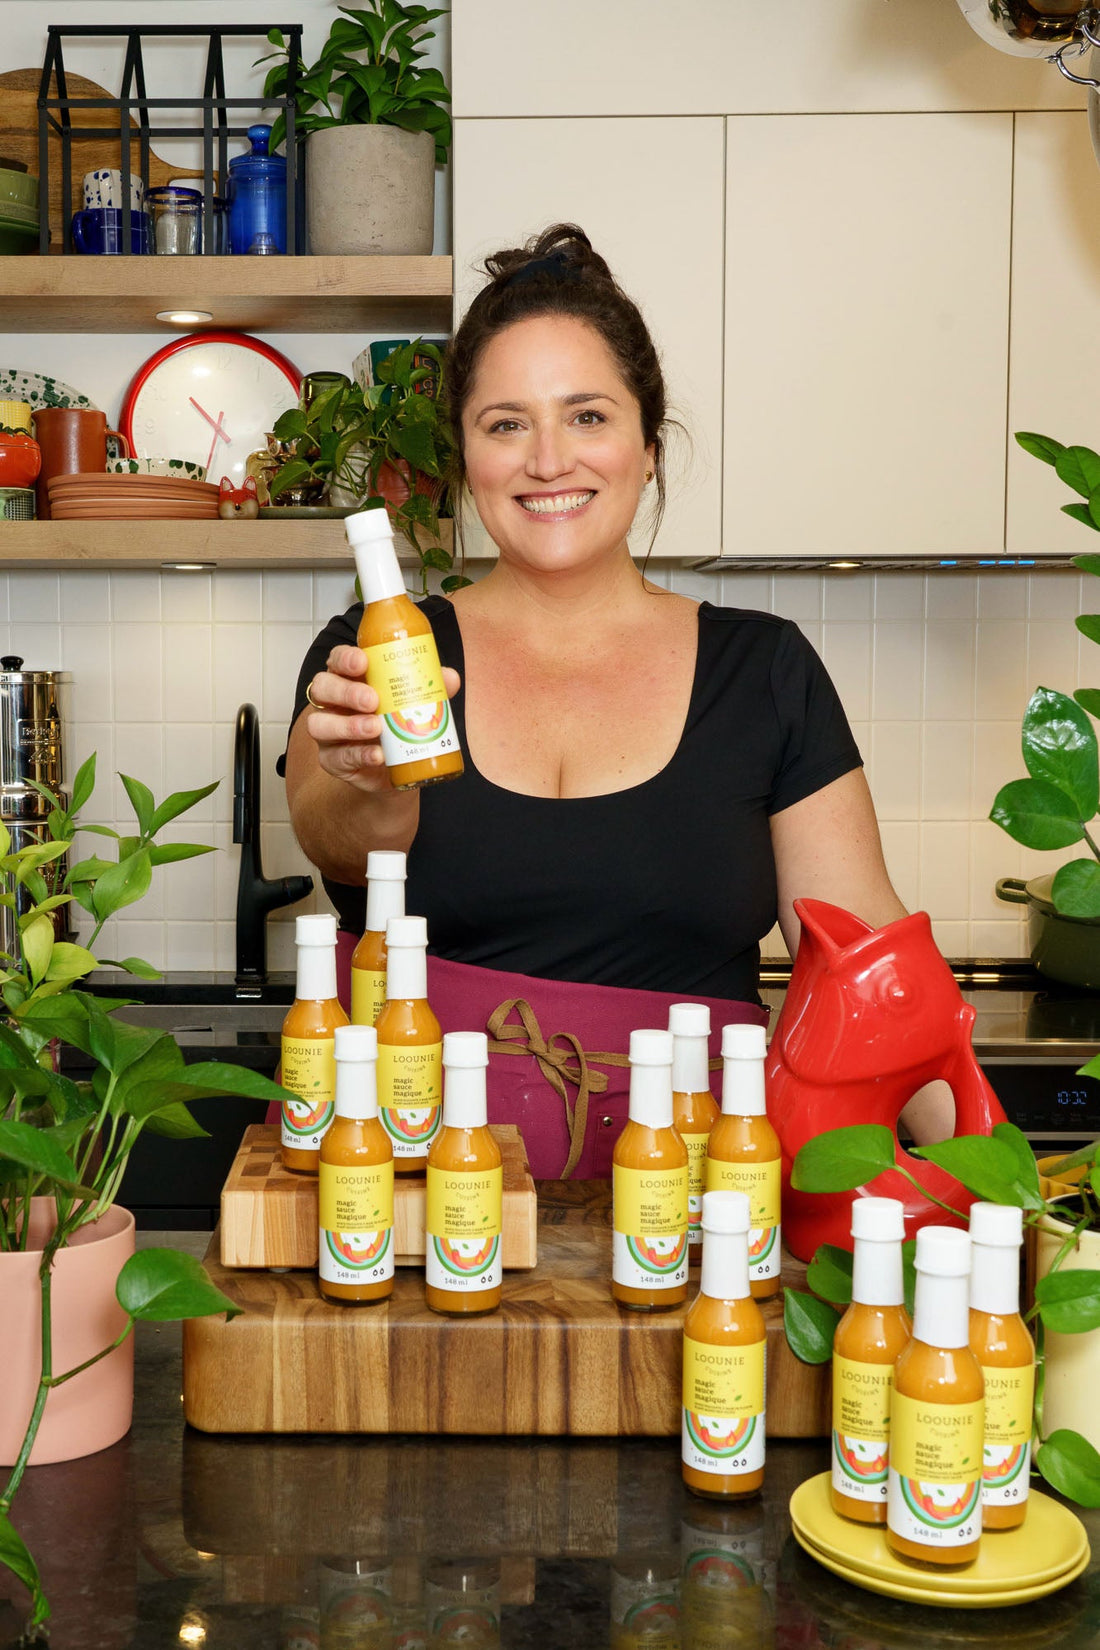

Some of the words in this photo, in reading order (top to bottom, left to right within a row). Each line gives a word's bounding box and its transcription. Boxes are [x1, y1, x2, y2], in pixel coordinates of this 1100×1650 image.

[383, 645, 428, 662] LOOUNIE
[284, 1046, 322, 1056] LOOUNIE
[393, 1053, 435, 1063] LOOUNIE
[336, 1174, 381, 1185] LOOUNIE
[721, 1171, 767, 1181] LOOUNIE
[445, 1180, 491, 1190] LOOUNIE
[640, 1177, 683, 1189] LOOUNIE
[445, 1205, 466, 1213] magic
[336, 1213, 367, 1221] magique
[445, 1219, 476, 1227] magique
[694, 1352, 745, 1366] LOOUNIE
[841, 1369, 893, 1386] LOOUNIE
[694, 1379, 716, 1388] magic
[694, 1386, 714, 1395] sauce
[694, 1393, 727, 1404] magique
[841, 1397, 863, 1408] magic
[841, 1405, 861, 1416] sauce
[841, 1413, 874, 1426] magique
[916, 1412, 974, 1426] LOOUNIE
[915, 1442, 943, 1452] magic
[915, 1450, 941, 1459] sauce
[914, 1458, 954, 1470] magique
